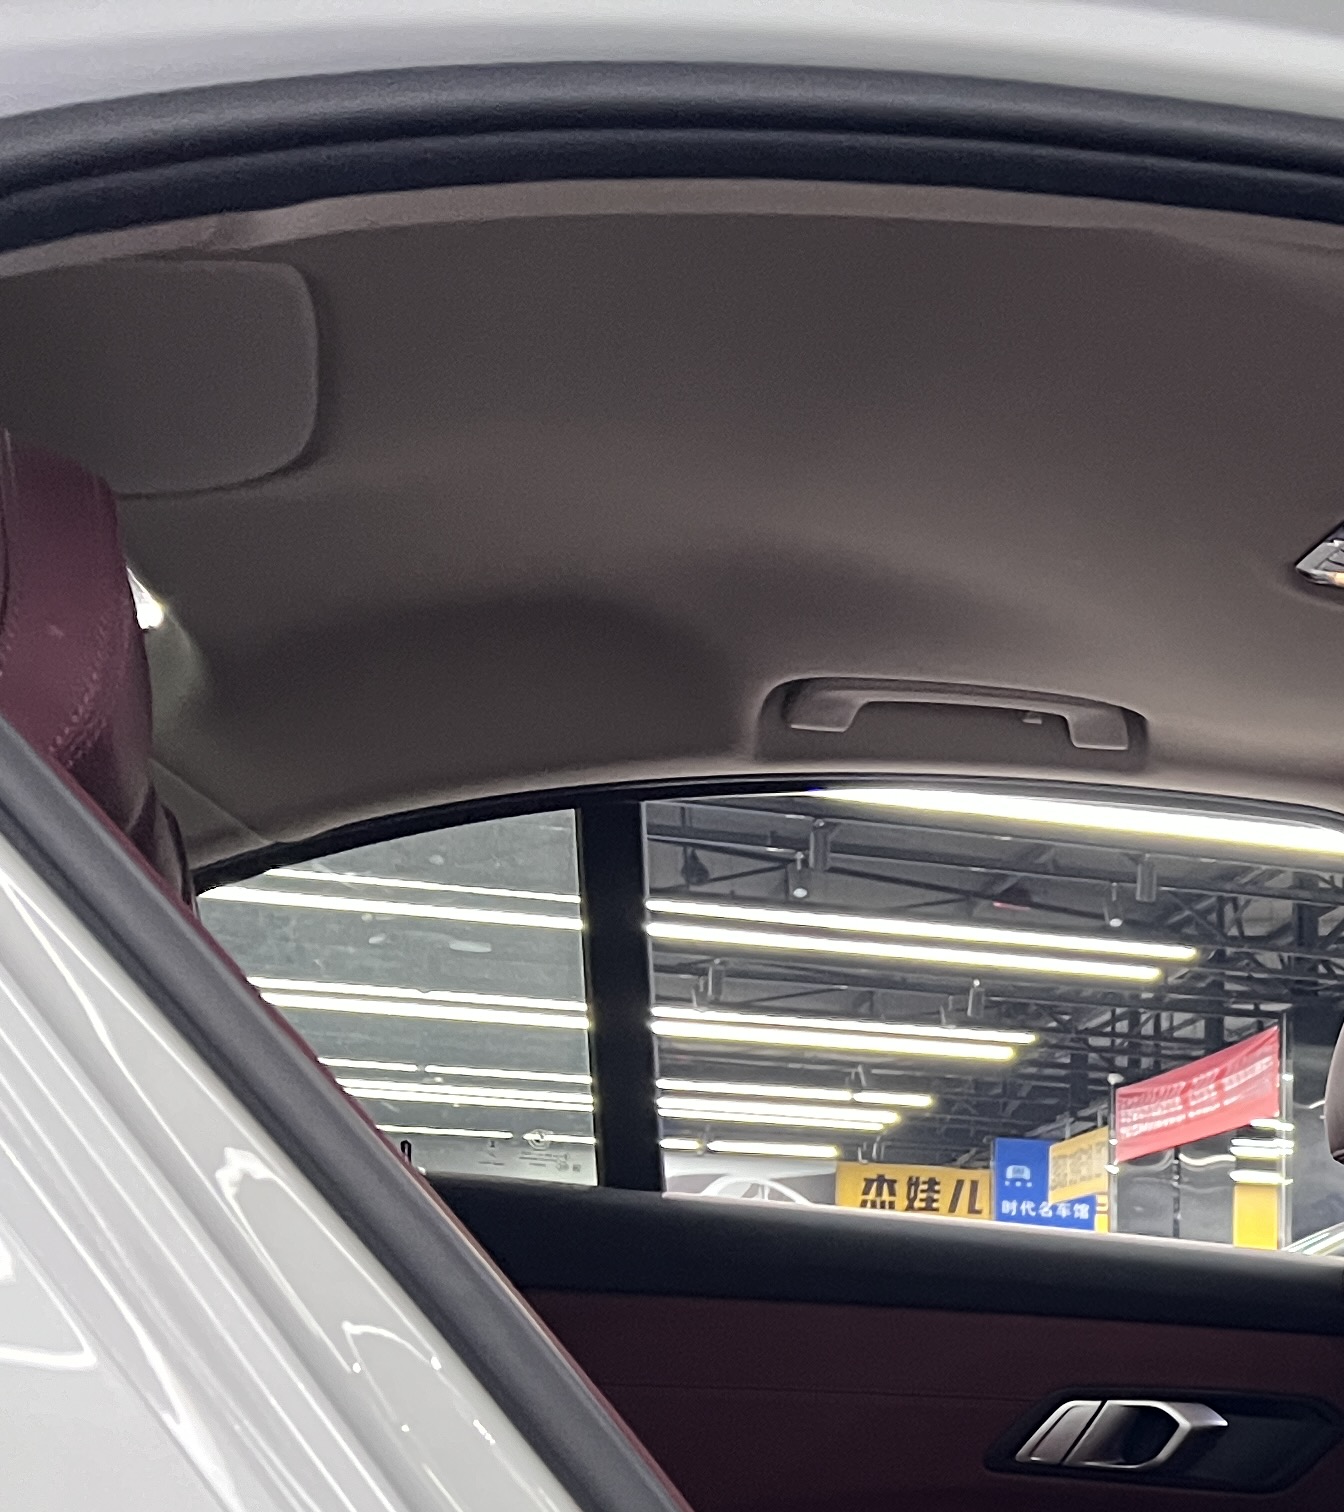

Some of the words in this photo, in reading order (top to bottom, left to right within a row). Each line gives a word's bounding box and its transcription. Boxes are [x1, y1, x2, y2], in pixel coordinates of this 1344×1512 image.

[1001, 1199, 1089, 1219] 时代名车馆
